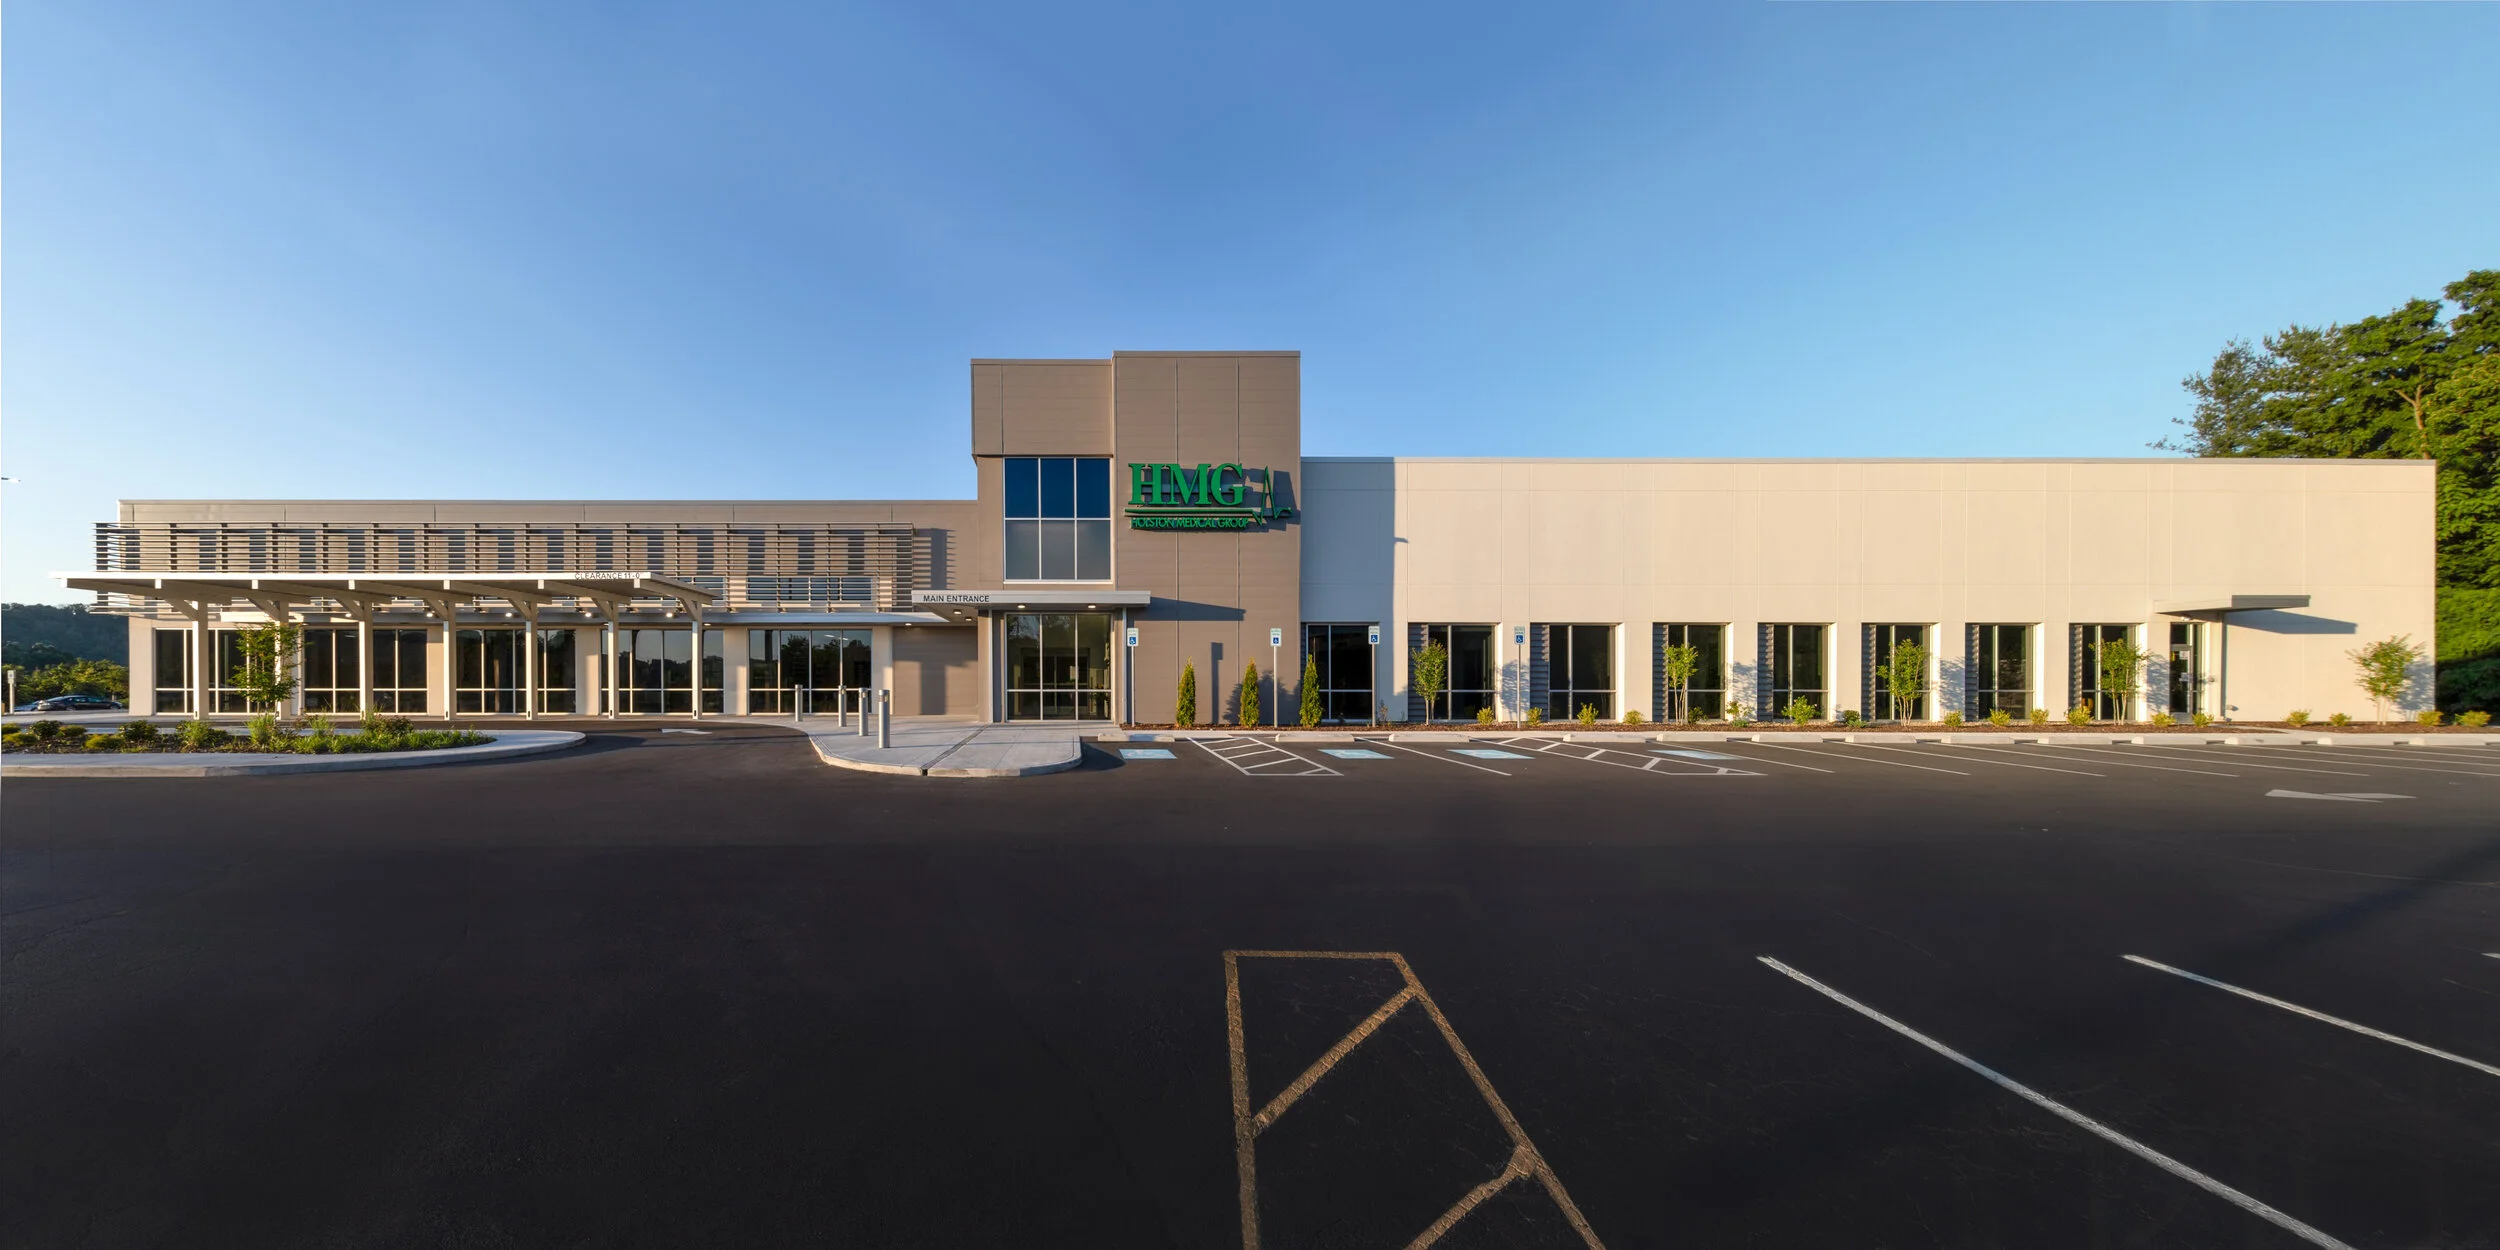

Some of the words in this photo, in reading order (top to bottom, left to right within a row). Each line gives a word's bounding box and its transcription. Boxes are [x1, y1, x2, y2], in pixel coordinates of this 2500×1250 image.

[1128, 463, 1247, 506] HMG
[1131, 517, 1174, 528] HOLSTON
[1176, 517, 1216, 528] MEDICAL
[1217, 517, 1249, 528] GROUP
[575, 572, 622, 580] CLEARANCE
